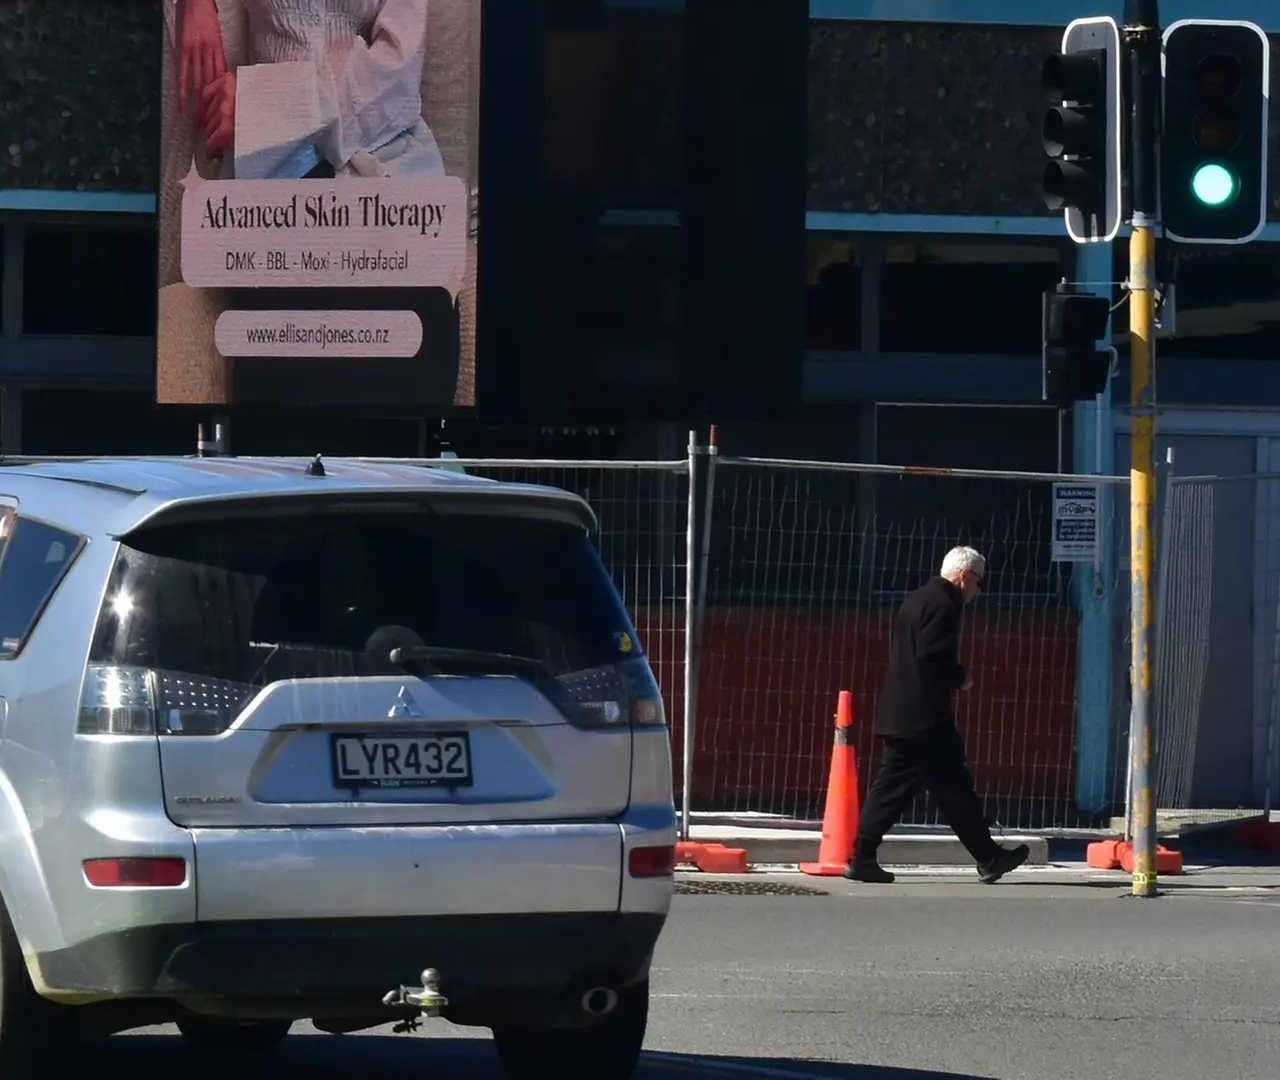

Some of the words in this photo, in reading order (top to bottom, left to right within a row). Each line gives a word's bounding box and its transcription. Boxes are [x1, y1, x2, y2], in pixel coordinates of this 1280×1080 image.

[200, 193, 297, 229] Advanced
[304, 192, 350, 229] Skin
[358, 193, 447, 238] Therapy
[225, 251, 256, 270] DMK
[266, 251, 290, 270] BBL
[301, 251, 331, 270] Moxi
[341, 249, 408, 276] Hydrafacial
[246, 323, 390, 349] www.ellisandjones.co.nz
[340, 742, 465, 776] LYR432
[380, 779, 401, 788] RAW
